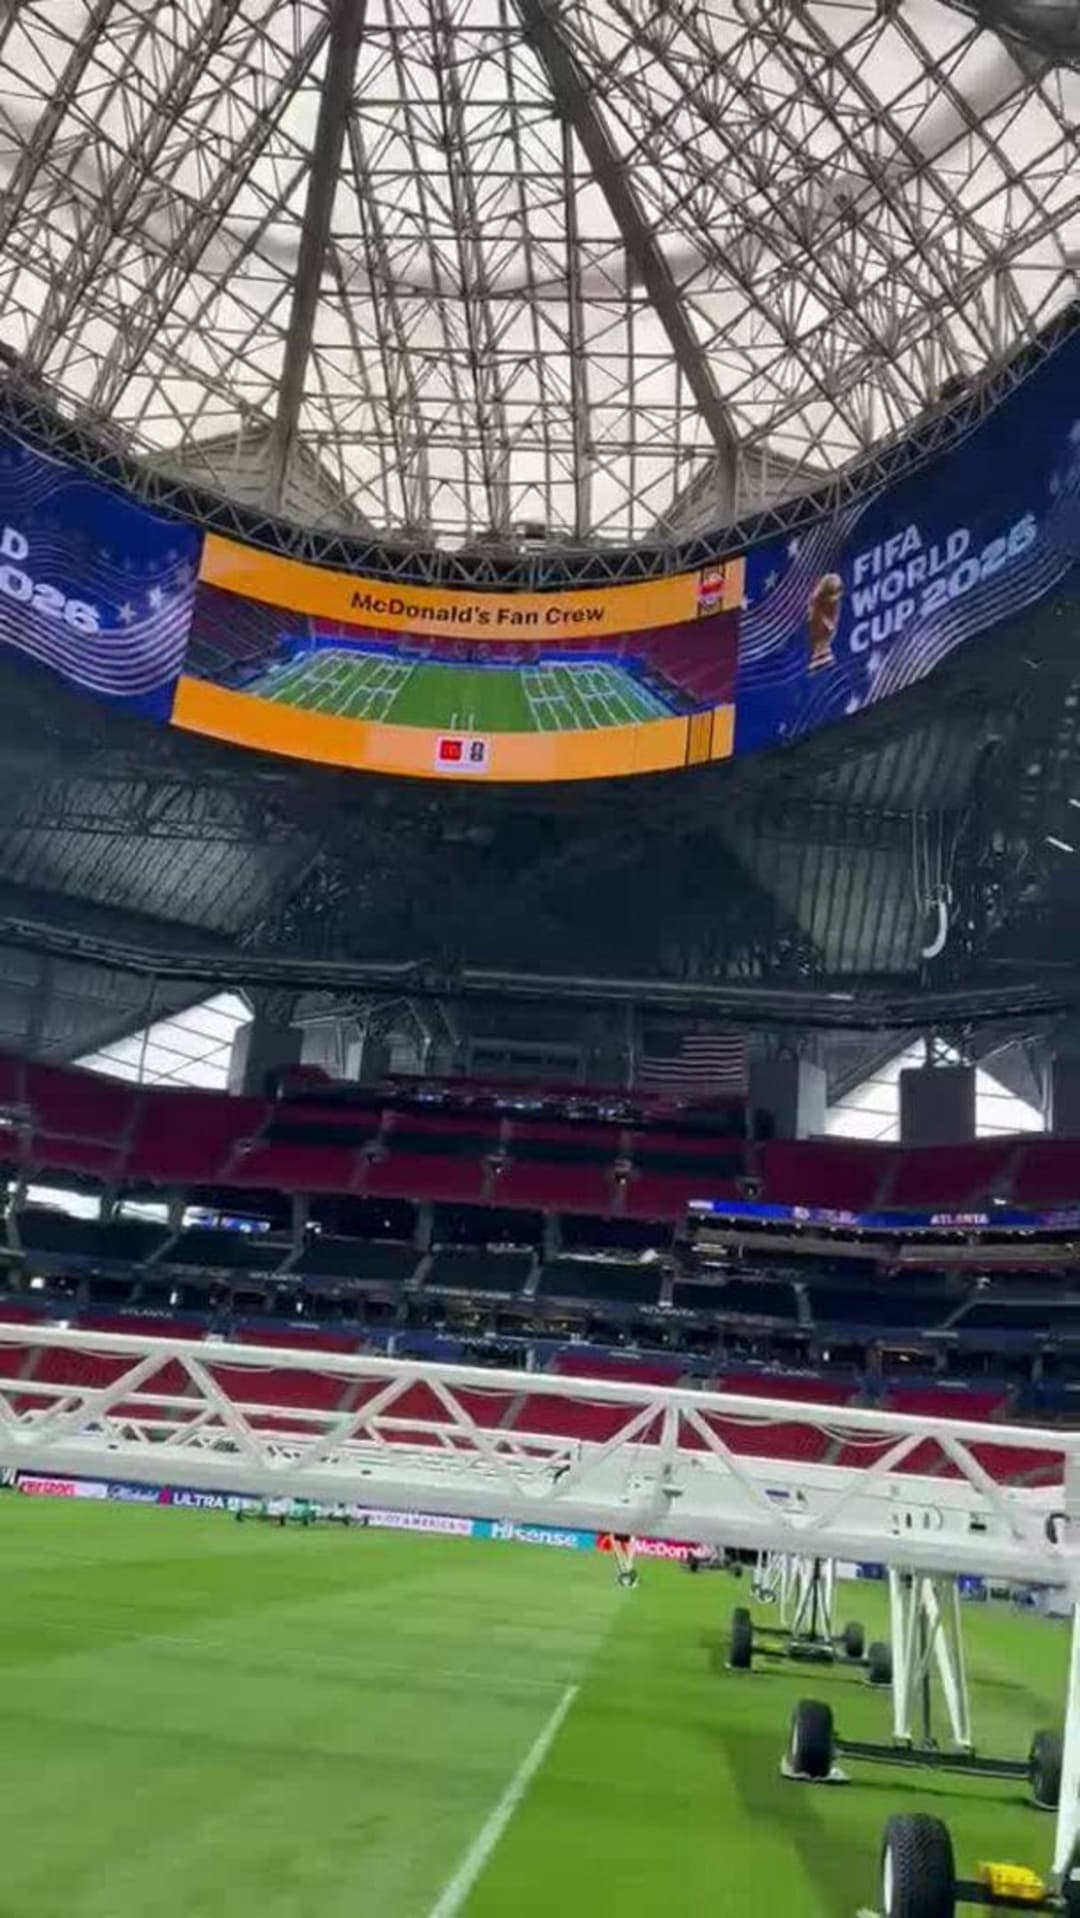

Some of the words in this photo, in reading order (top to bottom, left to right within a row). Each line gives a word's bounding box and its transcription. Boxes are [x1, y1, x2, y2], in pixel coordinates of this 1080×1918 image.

[854, 524, 923, 587] FIFA
[850, 597, 916, 653] CUP
[919, 512, 1037, 618] 2026
[852, 528, 970, 619] WORLD
[350, 591, 491, 626] McDonald's
[496, 604, 539, 626] Fan
[544, 606, 606, 626] Crew
[930, 1212, 989, 1226] ATLANTA
[173, 1491, 225, 1510] ULTRA
[491, 1523, 579, 1548] Hisense
